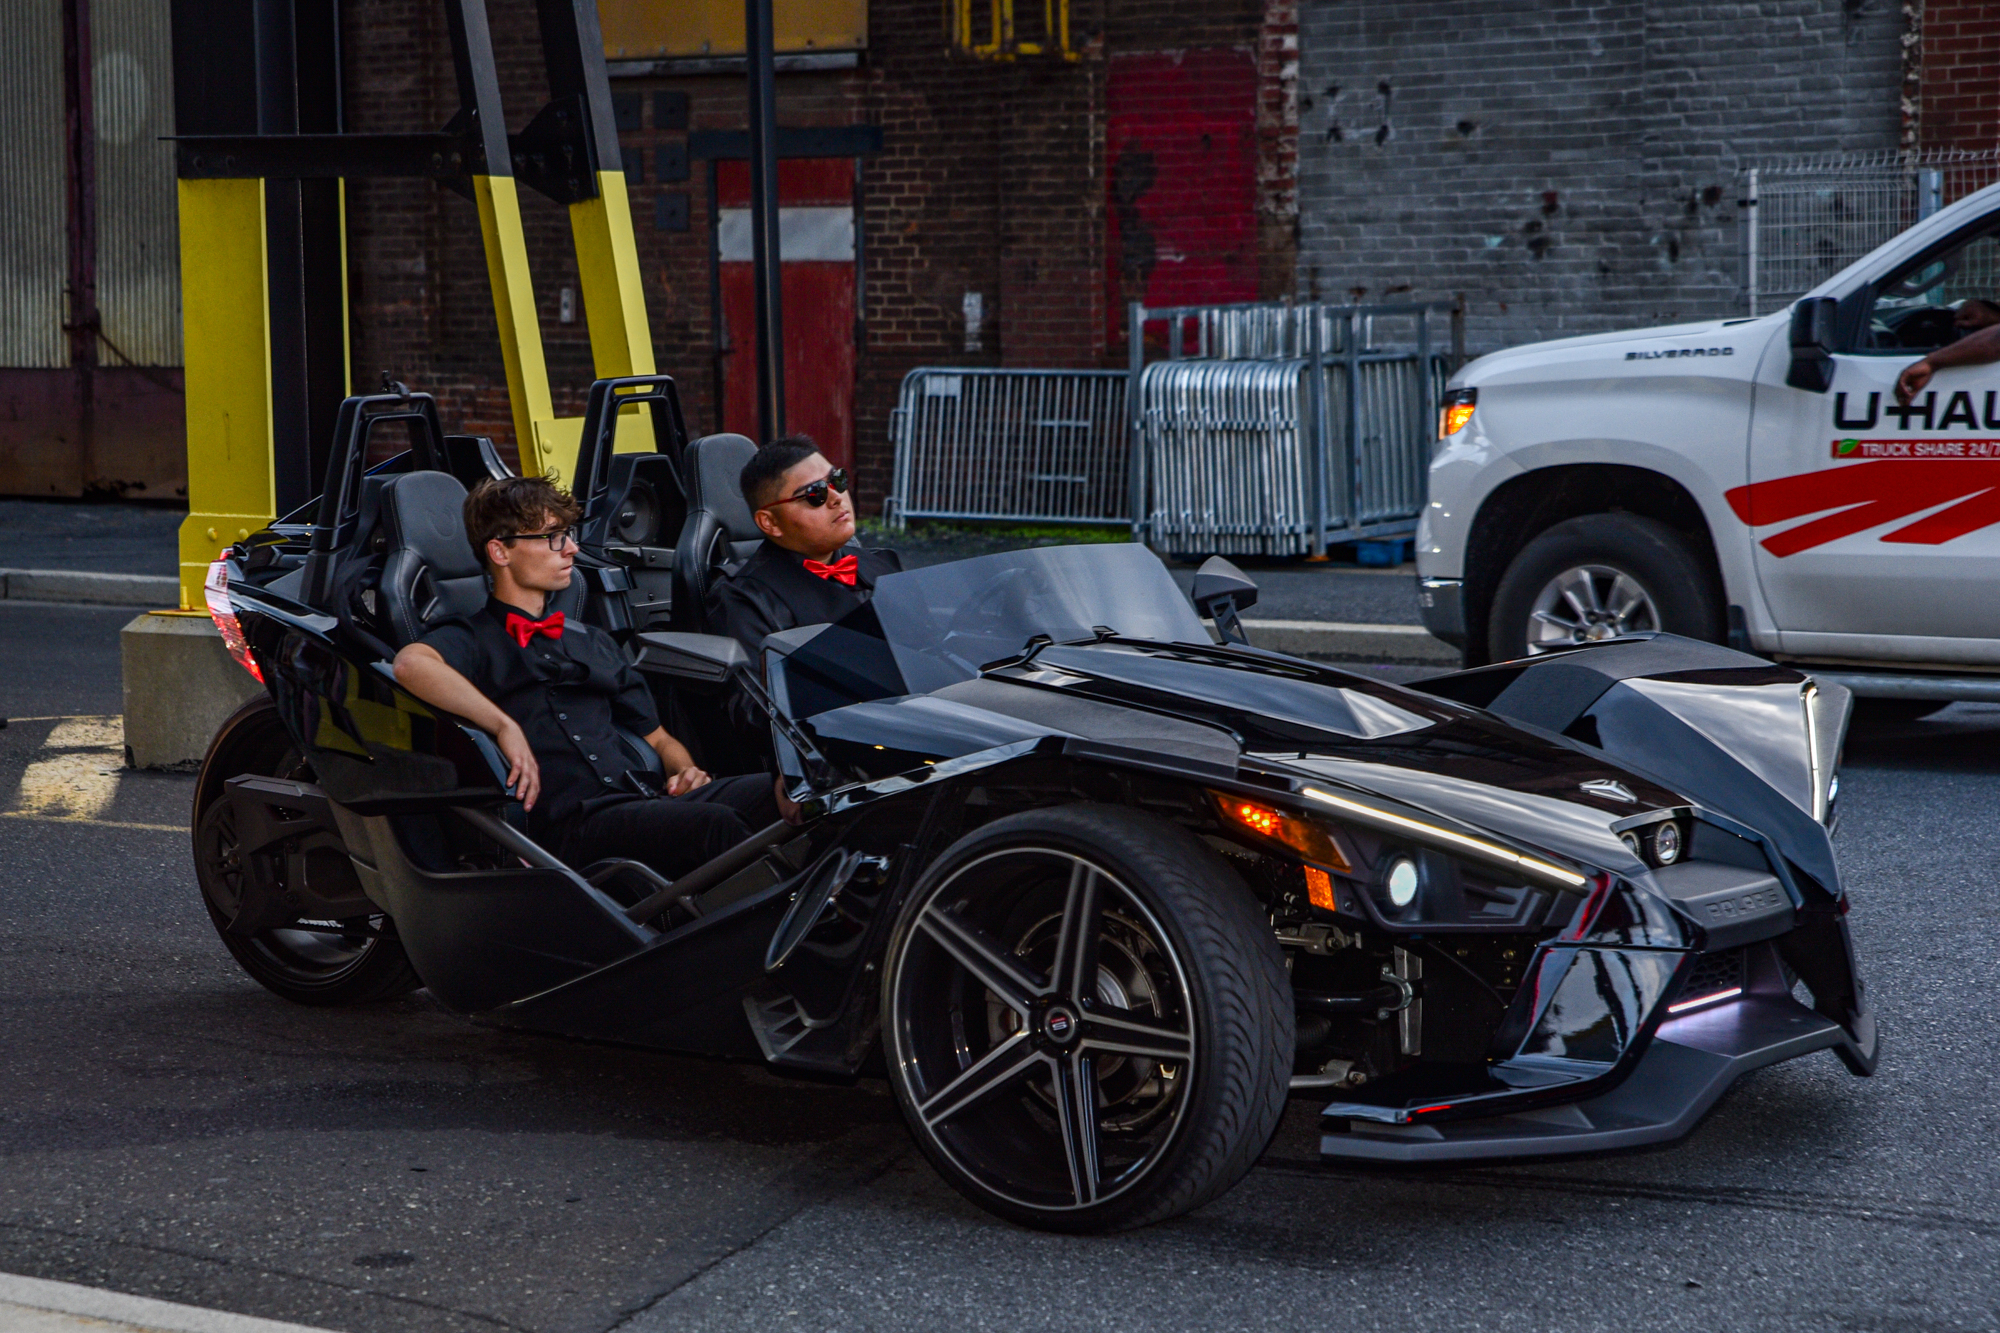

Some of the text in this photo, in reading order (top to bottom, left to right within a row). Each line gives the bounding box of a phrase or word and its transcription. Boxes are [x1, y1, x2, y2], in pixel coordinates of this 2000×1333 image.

[1624, 347, 1734, 360] SILVERADO
[1861, 443, 1911, 456] TRUCK
[1914, 442, 1965, 456] SHARE
[1705, 889, 1782, 921] POLARIS
